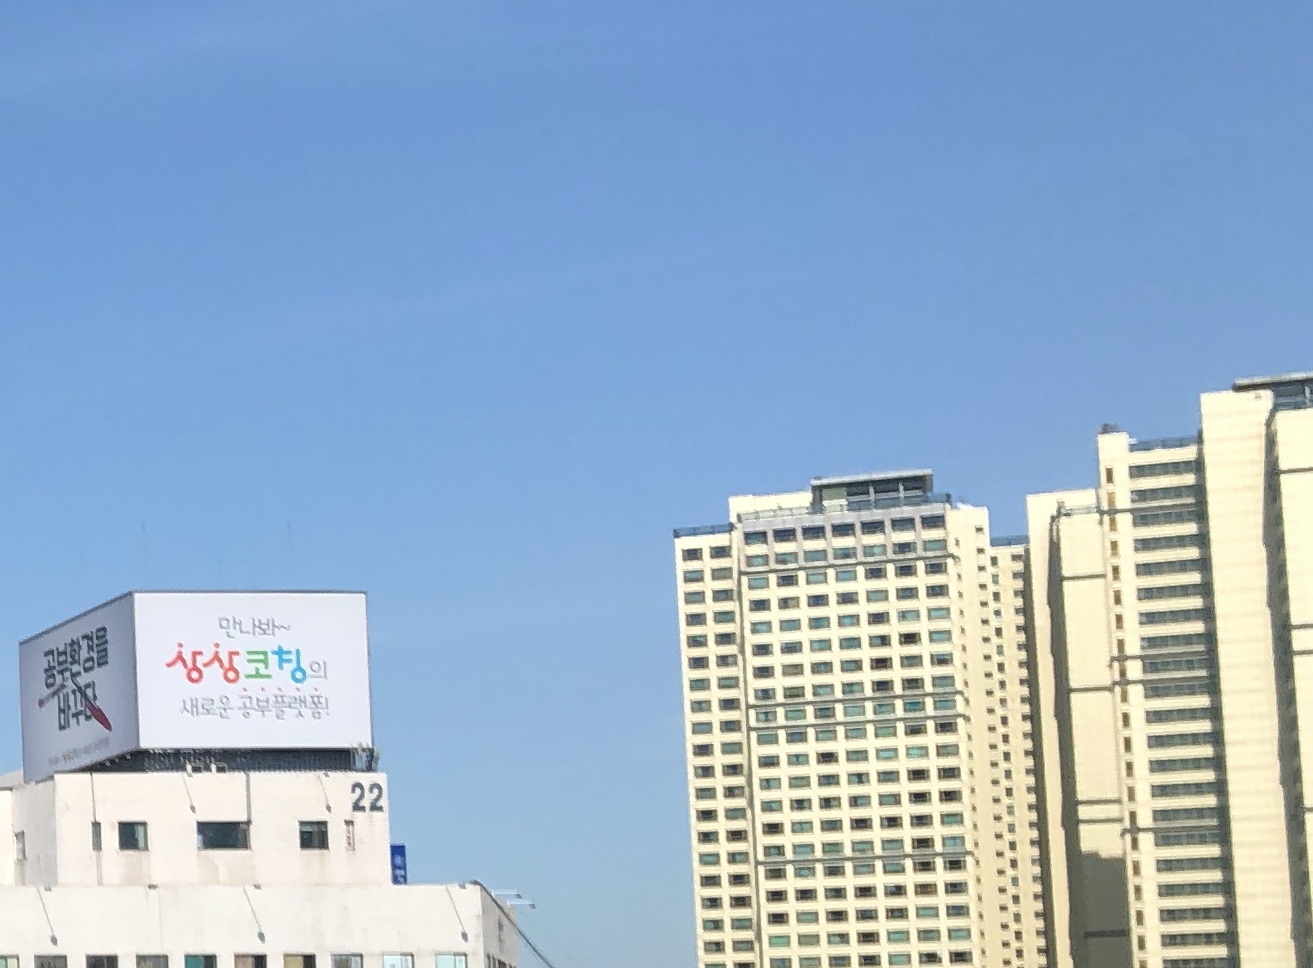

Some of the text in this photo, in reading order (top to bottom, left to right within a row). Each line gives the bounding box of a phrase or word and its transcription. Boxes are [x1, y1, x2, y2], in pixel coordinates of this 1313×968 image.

[43, 625, 109, 690] 공부환경을
[180, 694, 234, 720] 새로운
[350, 782, 385, 813] 22
